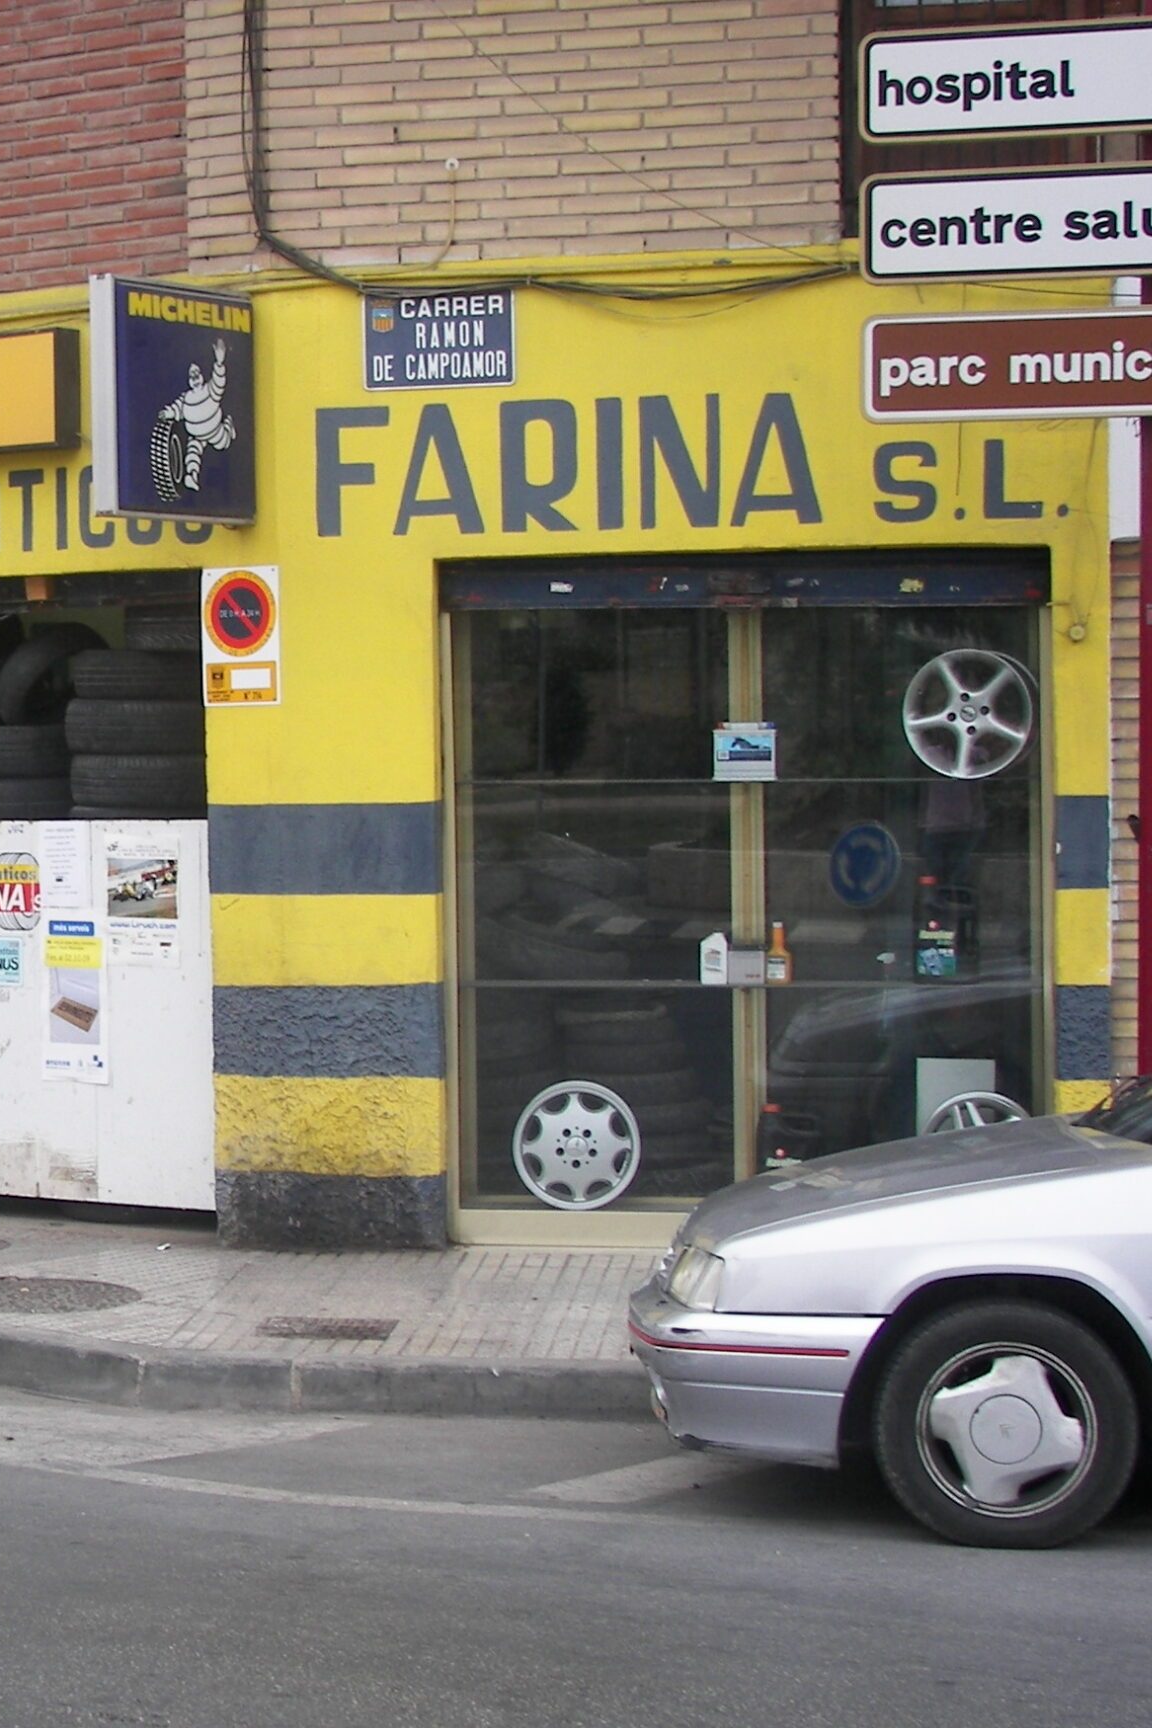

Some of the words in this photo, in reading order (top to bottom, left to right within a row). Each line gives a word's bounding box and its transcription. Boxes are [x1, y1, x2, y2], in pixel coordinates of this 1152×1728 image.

[878, 60, 1075, 112] hospital
[880, 206, 1043, 248] centre
[128, 291, 251, 334] MICHELIN
[400, 295, 504, 318] CARRER
[415, 320, 484, 349] RAMON
[373, 355, 394, 382] DE
[405, 350, 507, 380] CAMPOAMOR
[879, 354, 987, 397] parc
[315, 392, 824, 538] FARINA
[873, 438, 1070, 523] S.L.
